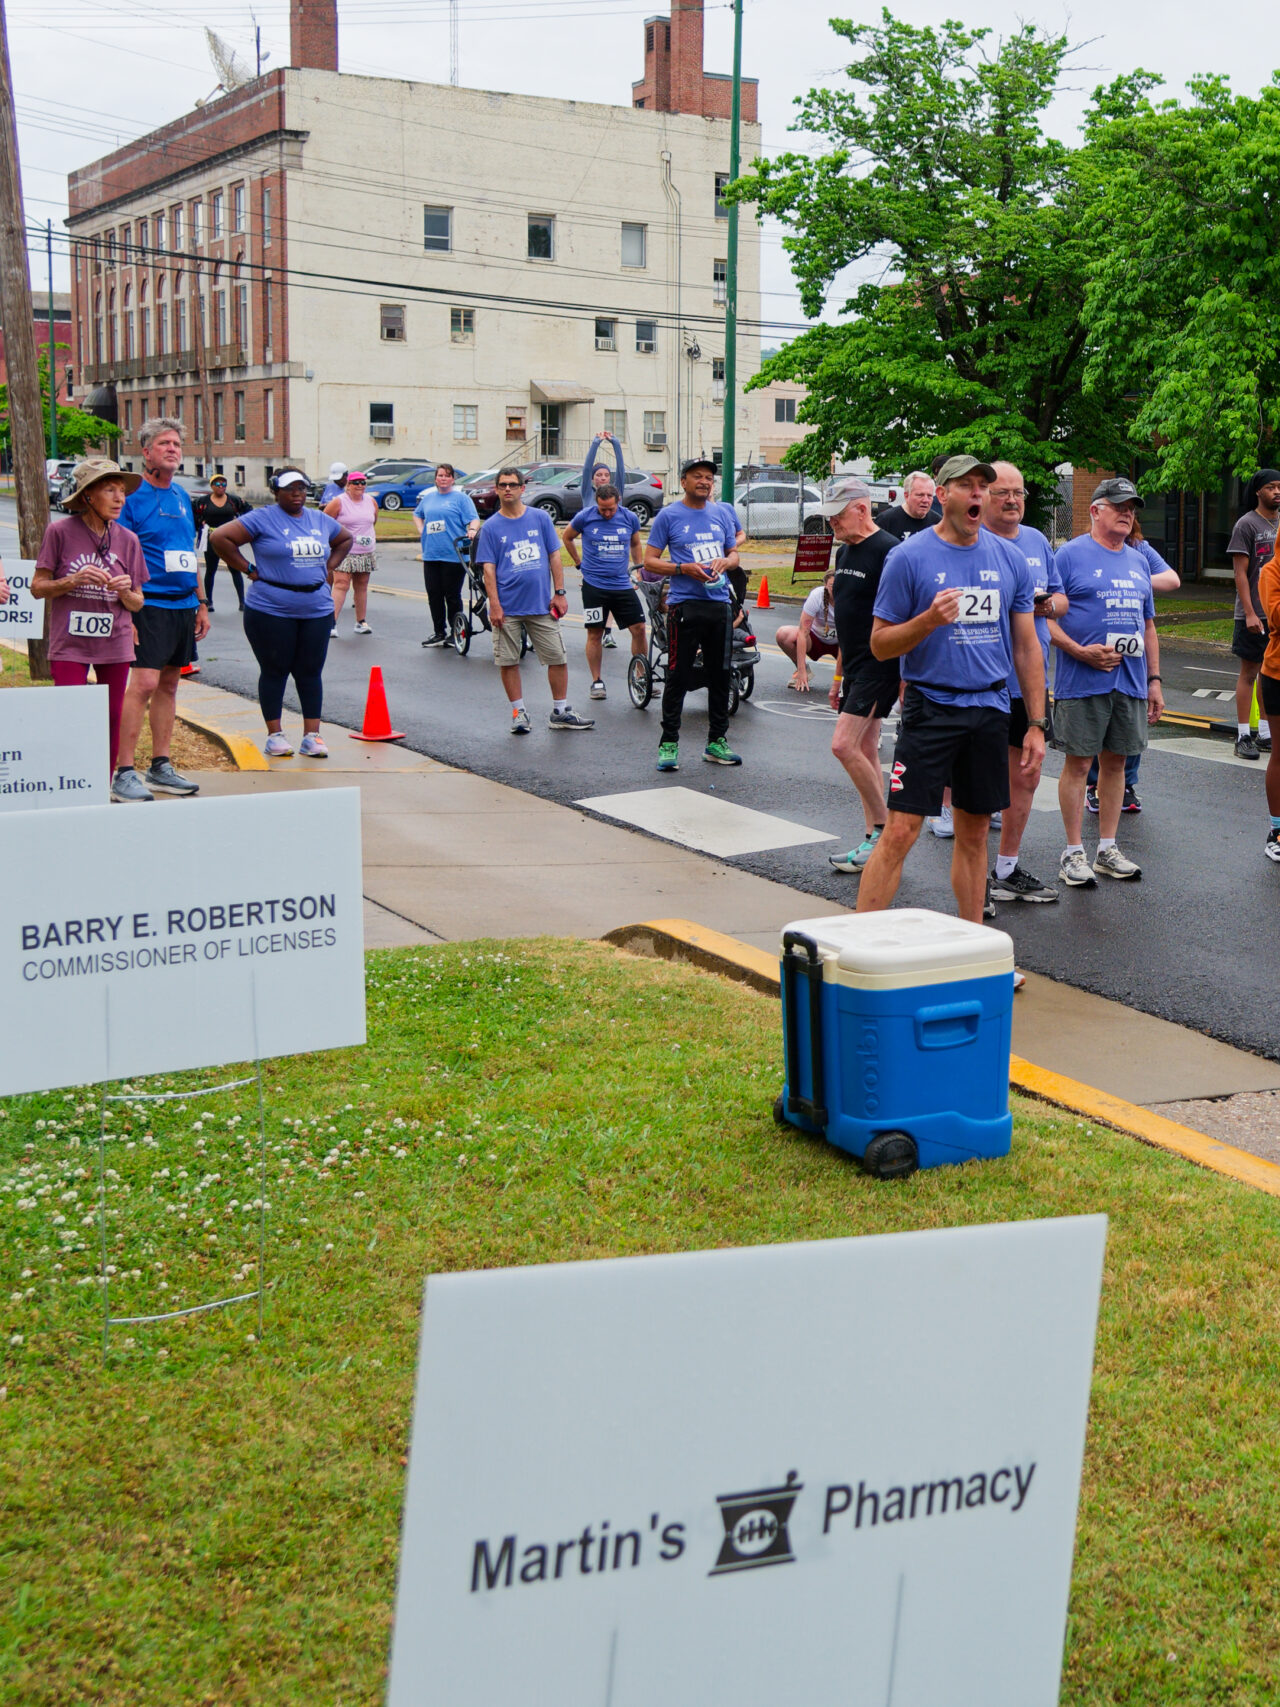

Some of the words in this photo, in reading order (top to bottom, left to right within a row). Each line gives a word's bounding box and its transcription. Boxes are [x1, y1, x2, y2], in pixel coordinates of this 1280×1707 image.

[430, 522, 442, 532] 42
[360, 536, 371, 546] 58
[296, 543, 322, 556] 110
[518, 547, 535, 560] 62
[696, 546, 720, 562] 111
[179, 554, 189, 568] 6
[6, 576, 31, 589] YOU
[1096, 589, 1122, 599] Spring
[1123, 589, 1137, 597] Run
[965, 594, 992, 616] 24
[586, 610, 600, 621] 50
[74, 616, 111, 634] 108
[1114, 637, 1139, 655] 60
[0, 750, 23, 761] rn
[0, 777, 54, 794] ation,
[58, 776, 92, 791] Inc.
[22, 915, 123, 950] BARRY
[133, 913, 157, 938] E.
[168, 893, 336, 935] ROBERTSON
[23, 943, 197, 981] COMMISSIONER
[204, 939, 231, 960] OF
[238, 928, 336, 956] LICENSES
[469, 1512, 686, 1593] Martin's
[822, 1461, 1037, 1535] Pharmacy
